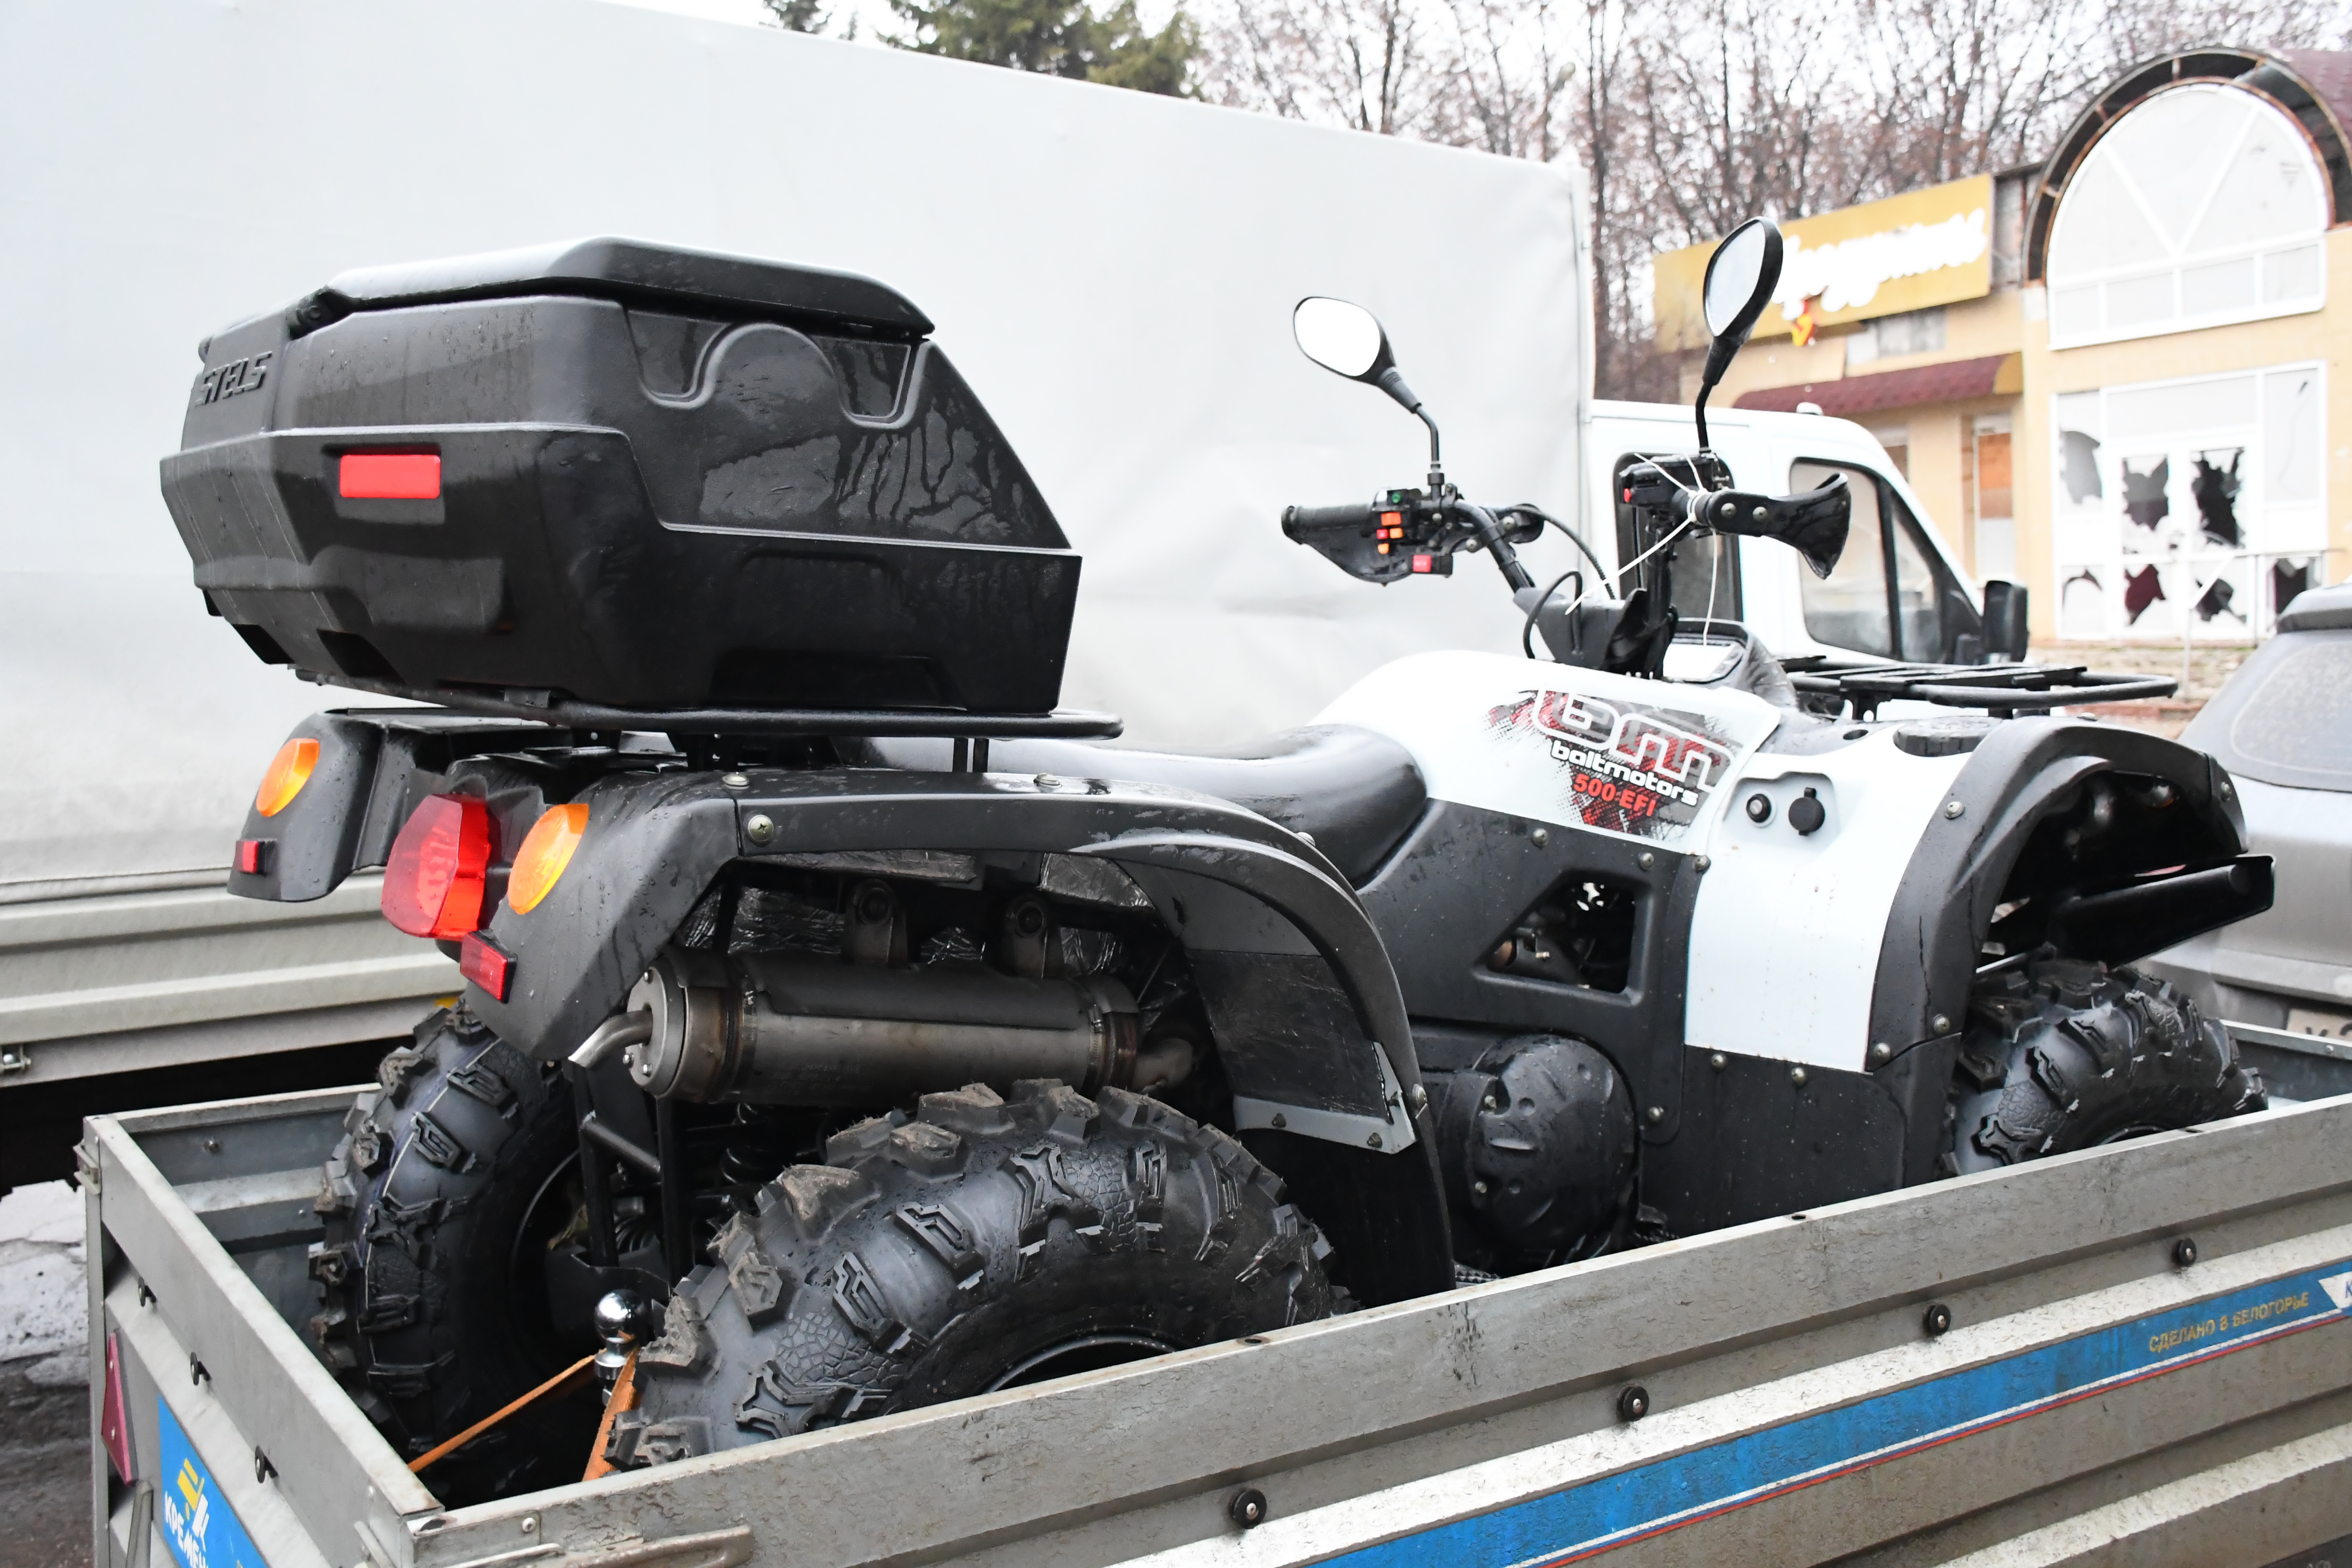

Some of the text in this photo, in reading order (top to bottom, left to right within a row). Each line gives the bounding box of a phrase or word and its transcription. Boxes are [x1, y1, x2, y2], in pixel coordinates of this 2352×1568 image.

[194, 351, 272, 407] STELS
[1551, 740, 1700, 806] baltmotors
[1573, 773, 1656, 817] 500 EFI
[2149, 1291, 2309, 1353] СДЕЛАНО В БЕЛОГОРЬЕ
